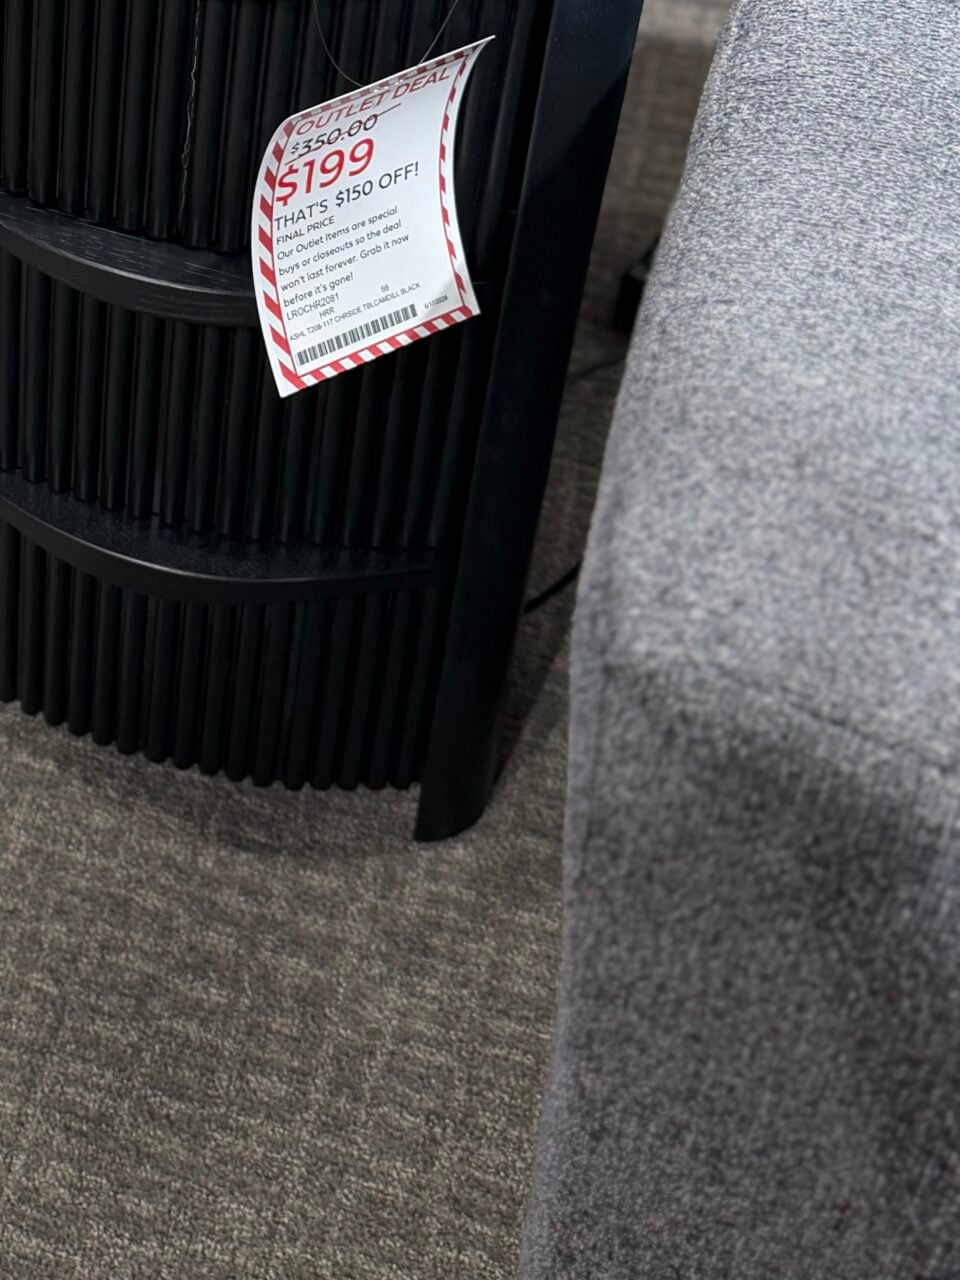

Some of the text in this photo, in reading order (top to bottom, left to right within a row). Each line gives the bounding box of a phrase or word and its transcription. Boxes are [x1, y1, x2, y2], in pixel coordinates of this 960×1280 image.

[296, 68, 449, 135] OUTLET DEAL
[291, 114, 378, 157] $350.00
[275, 161, 419, 230] THAT'S $150 OFF!
[276, 138, 374, 206] $199
[276, 215, 335, 246] FINAL PRICE
[277, 205, 397, 261] Our Outlet Items are special
[279, 220, 401, 276] buys or closeouts so the deal
[281, 234, 409, 291] won't last forever. Grab it now
[284, 272, 353, 308] before it's gone!
[400, 282, 421, 295] BLACK
[286, 292, 339, 321] LROCHR2081
